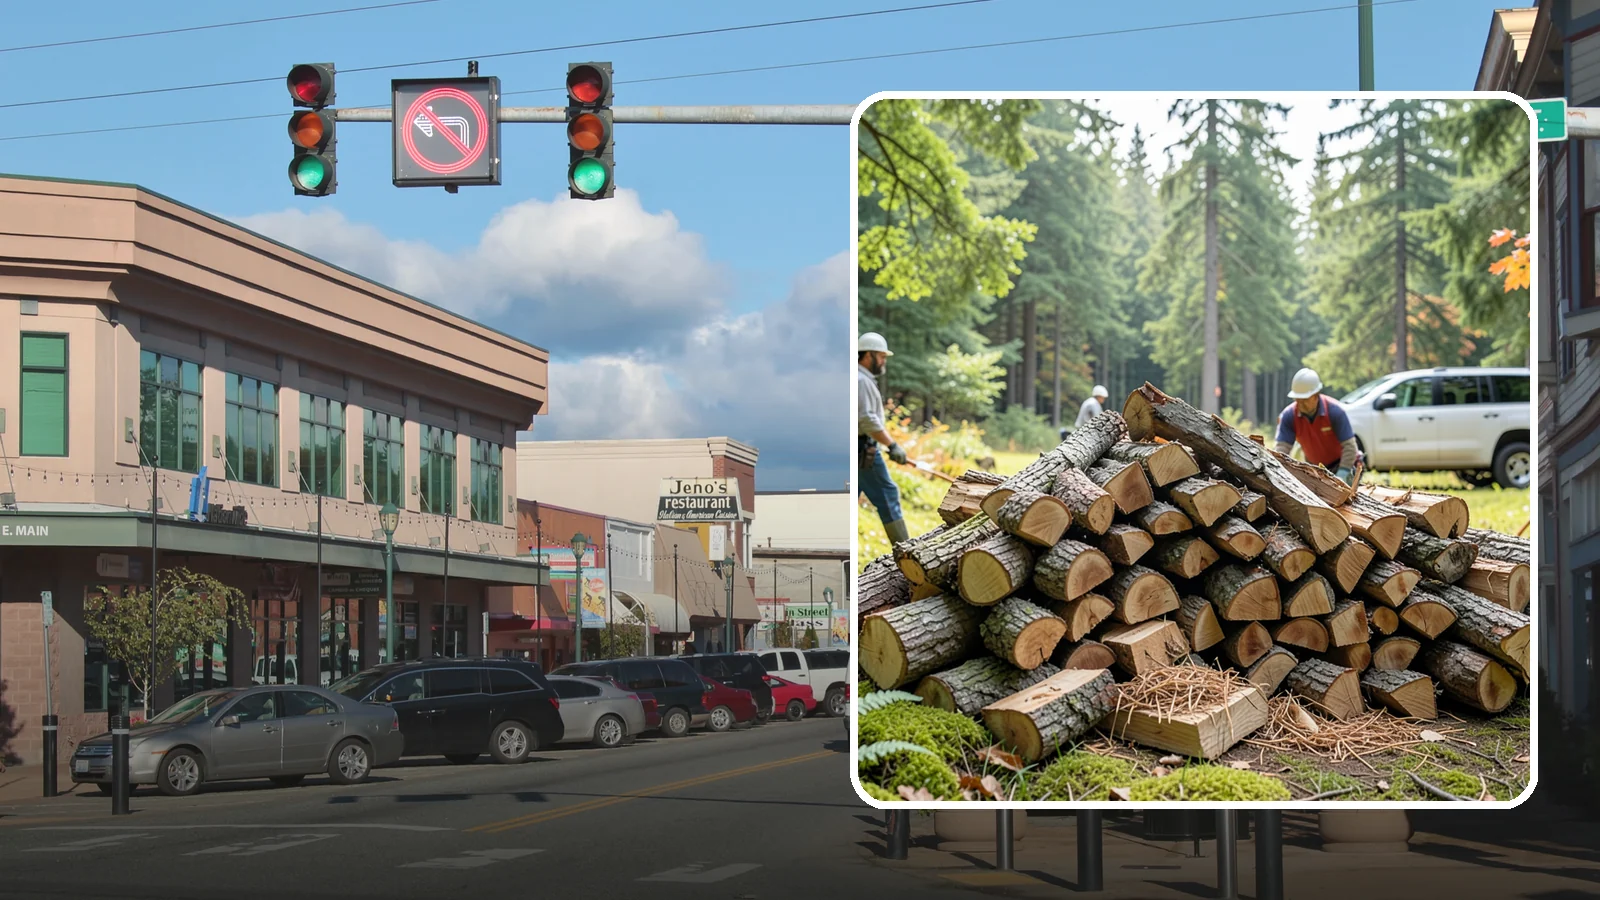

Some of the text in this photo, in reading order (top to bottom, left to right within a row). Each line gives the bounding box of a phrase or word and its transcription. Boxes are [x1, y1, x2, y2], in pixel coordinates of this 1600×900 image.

[670, 480, 727, 494] Jeno's
[665, 496, 731, 509] restaurant
[658, 509, 681, 519] Italian
[686, 509, 714, 519] American
[715, 509, 738, 519] Cuisine
[2, 525, 49, 536] E. MAIN
[797, 607, 828, 616] Street
